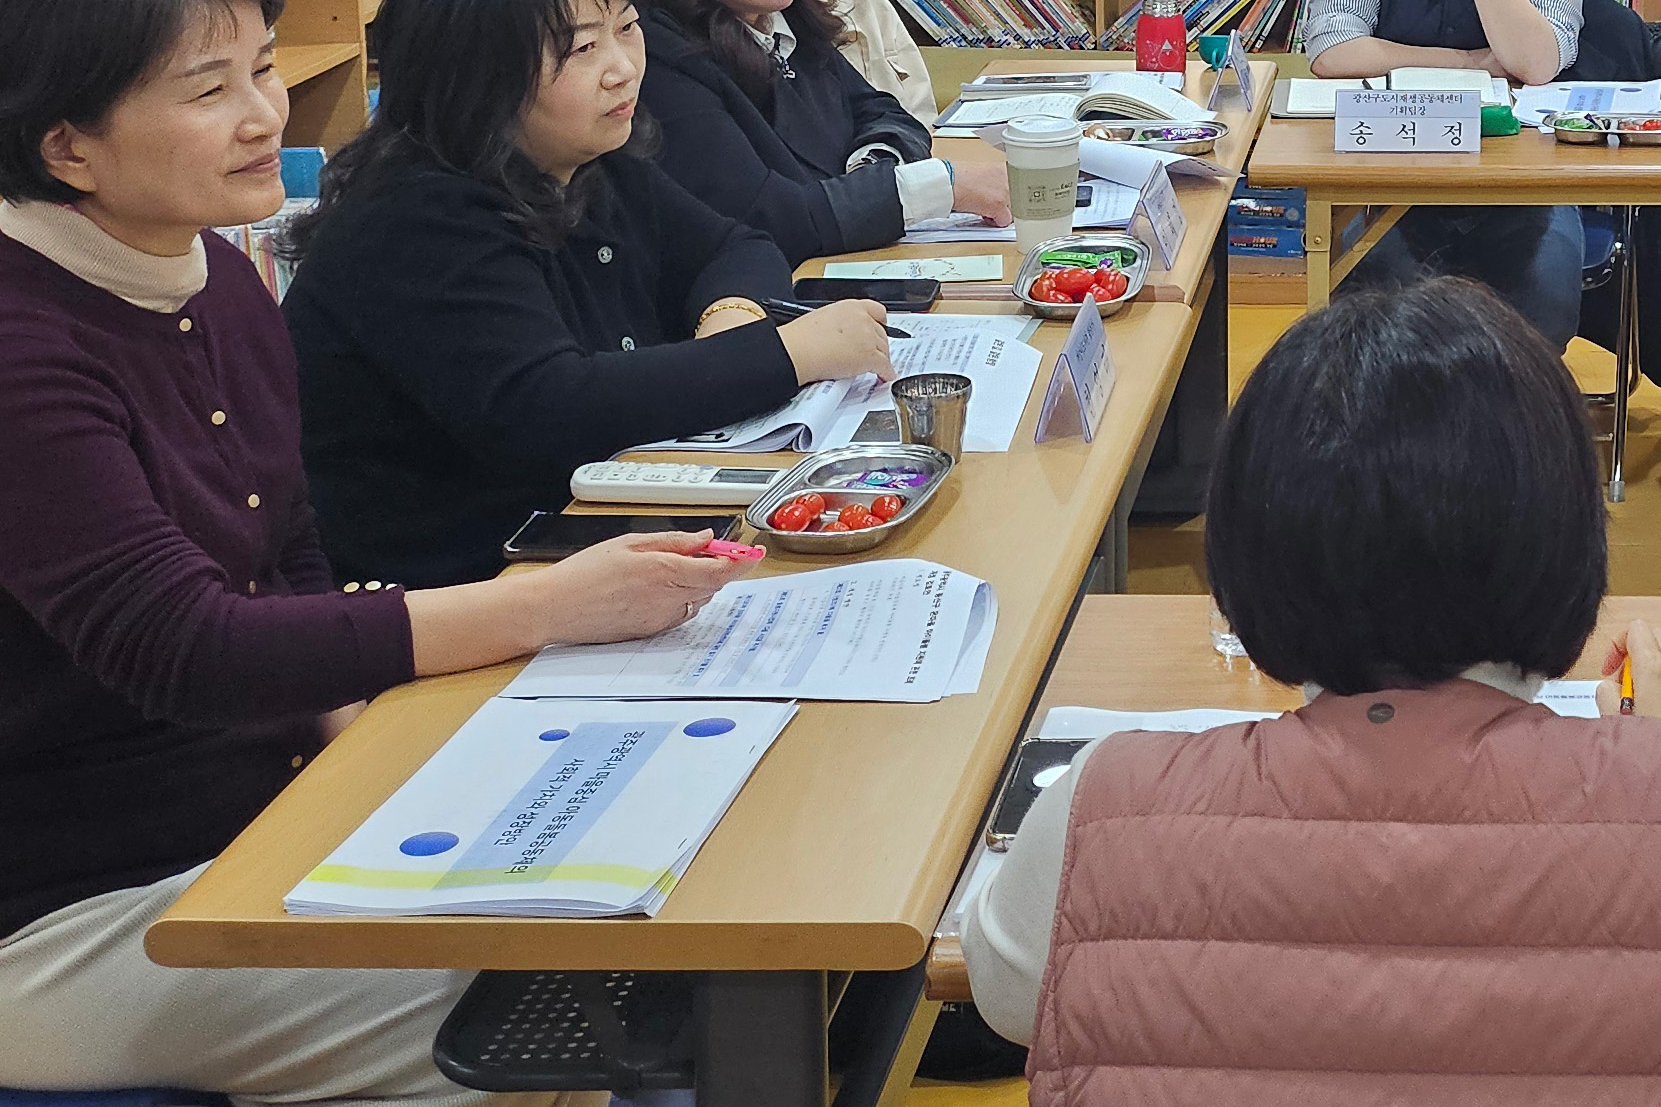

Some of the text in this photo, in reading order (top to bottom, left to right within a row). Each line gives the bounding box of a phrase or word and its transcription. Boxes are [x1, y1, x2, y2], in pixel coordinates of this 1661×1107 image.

[494, 758, 585, 846] 사회적 가치와 성장방안
[505, 730, 646, 874] 광주광역시 마을중심 아동돌봄공동체의
